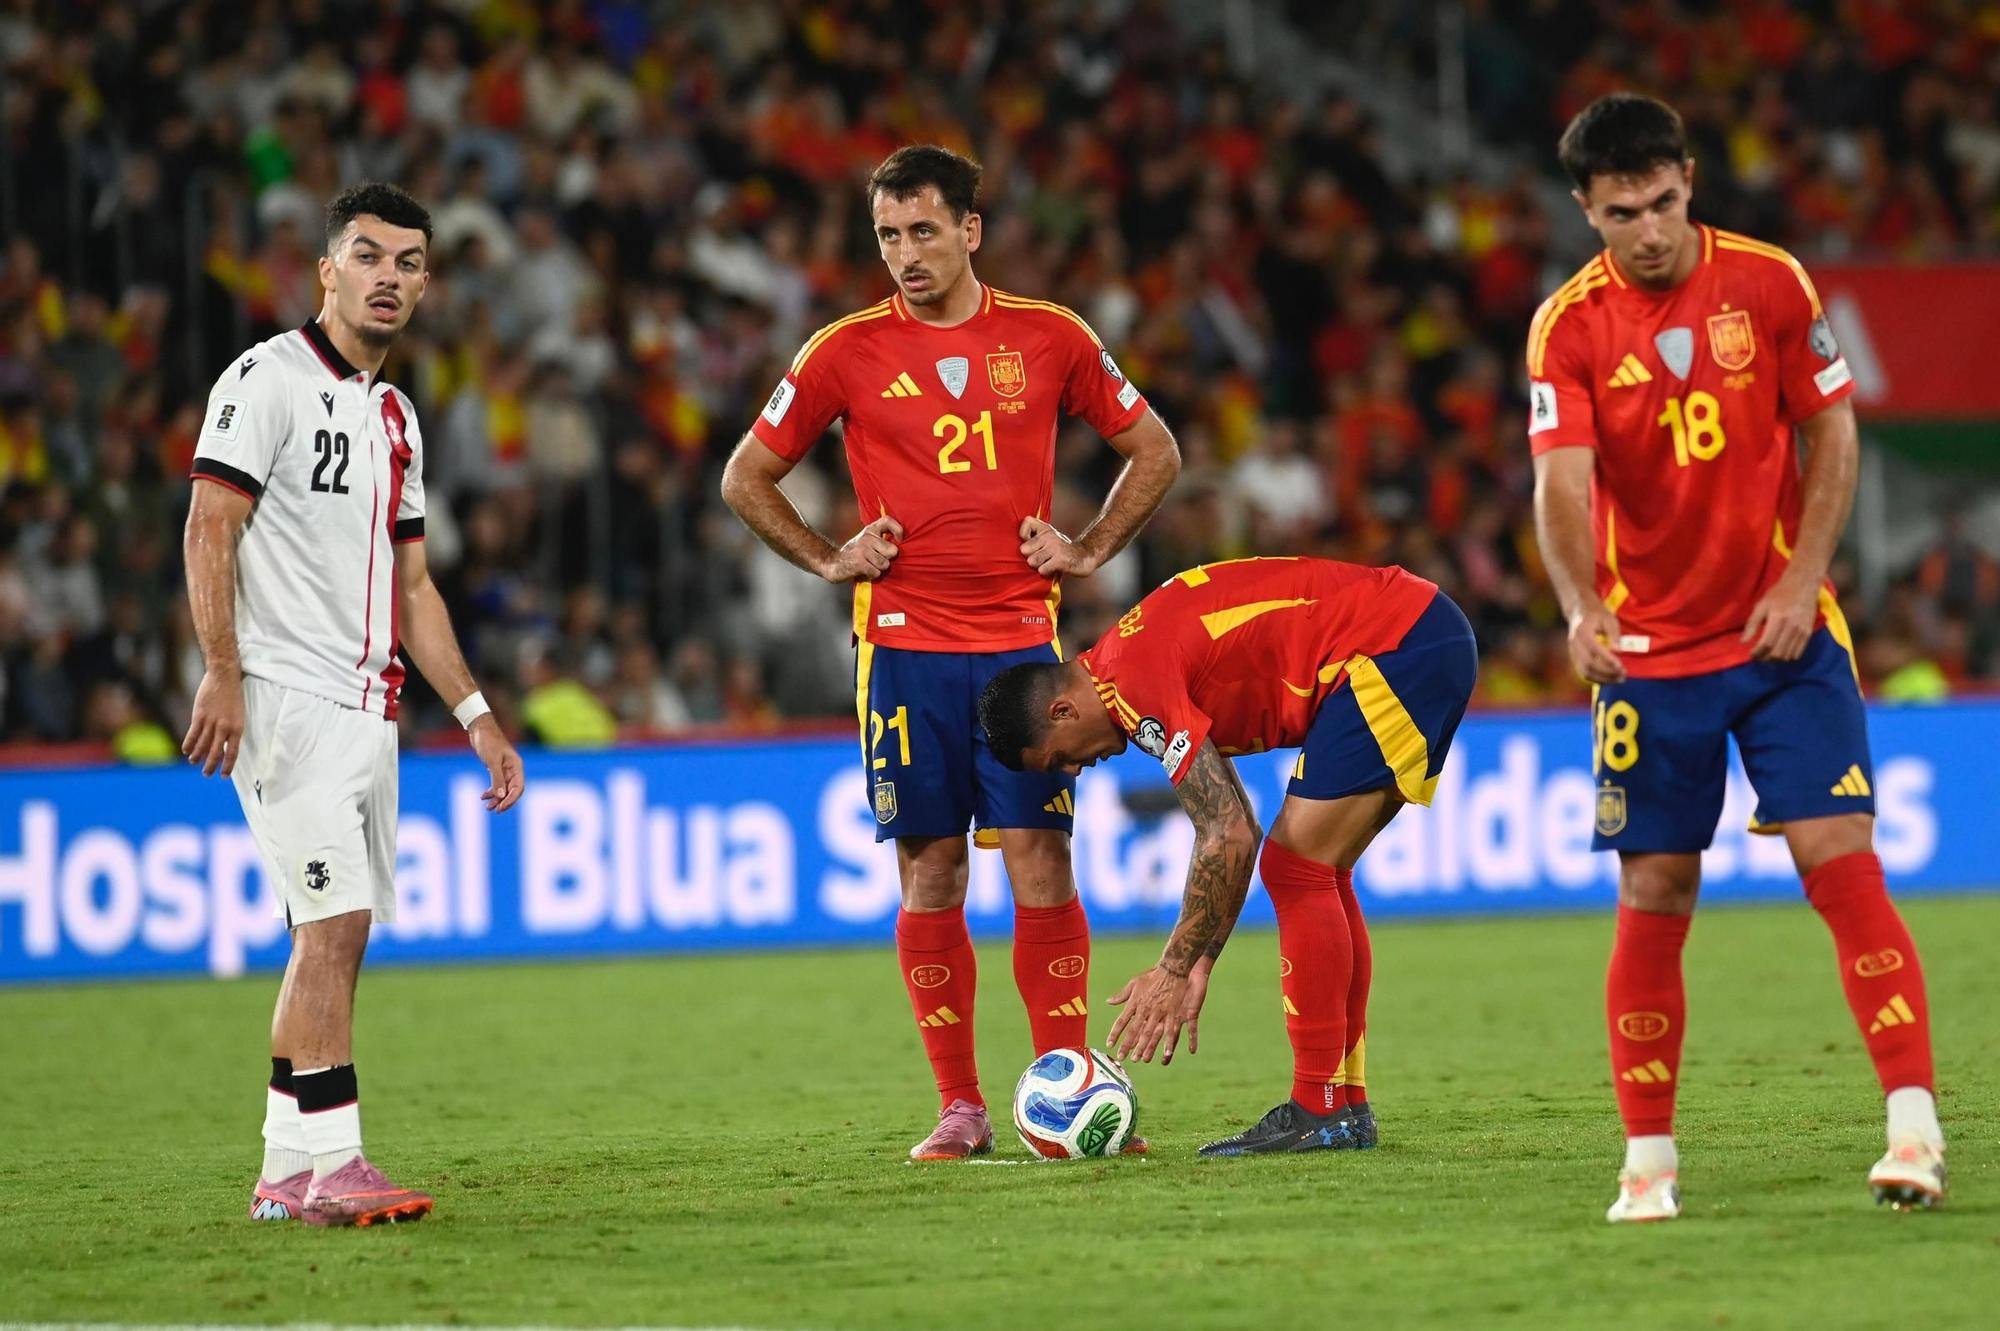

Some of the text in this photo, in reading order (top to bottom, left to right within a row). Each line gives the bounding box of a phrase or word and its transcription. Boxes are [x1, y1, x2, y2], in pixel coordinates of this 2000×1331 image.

[311, 429, 350, 494] 22
[933, 410, 997, 474] 21
[1657, 390, 1727, 467] 18
[870, 706, 911, 770] 21
[1593, 700, 1640, 774] 18
[0, 770, 492, 978] Hospal
[519, 769, 797, 934] Blua
